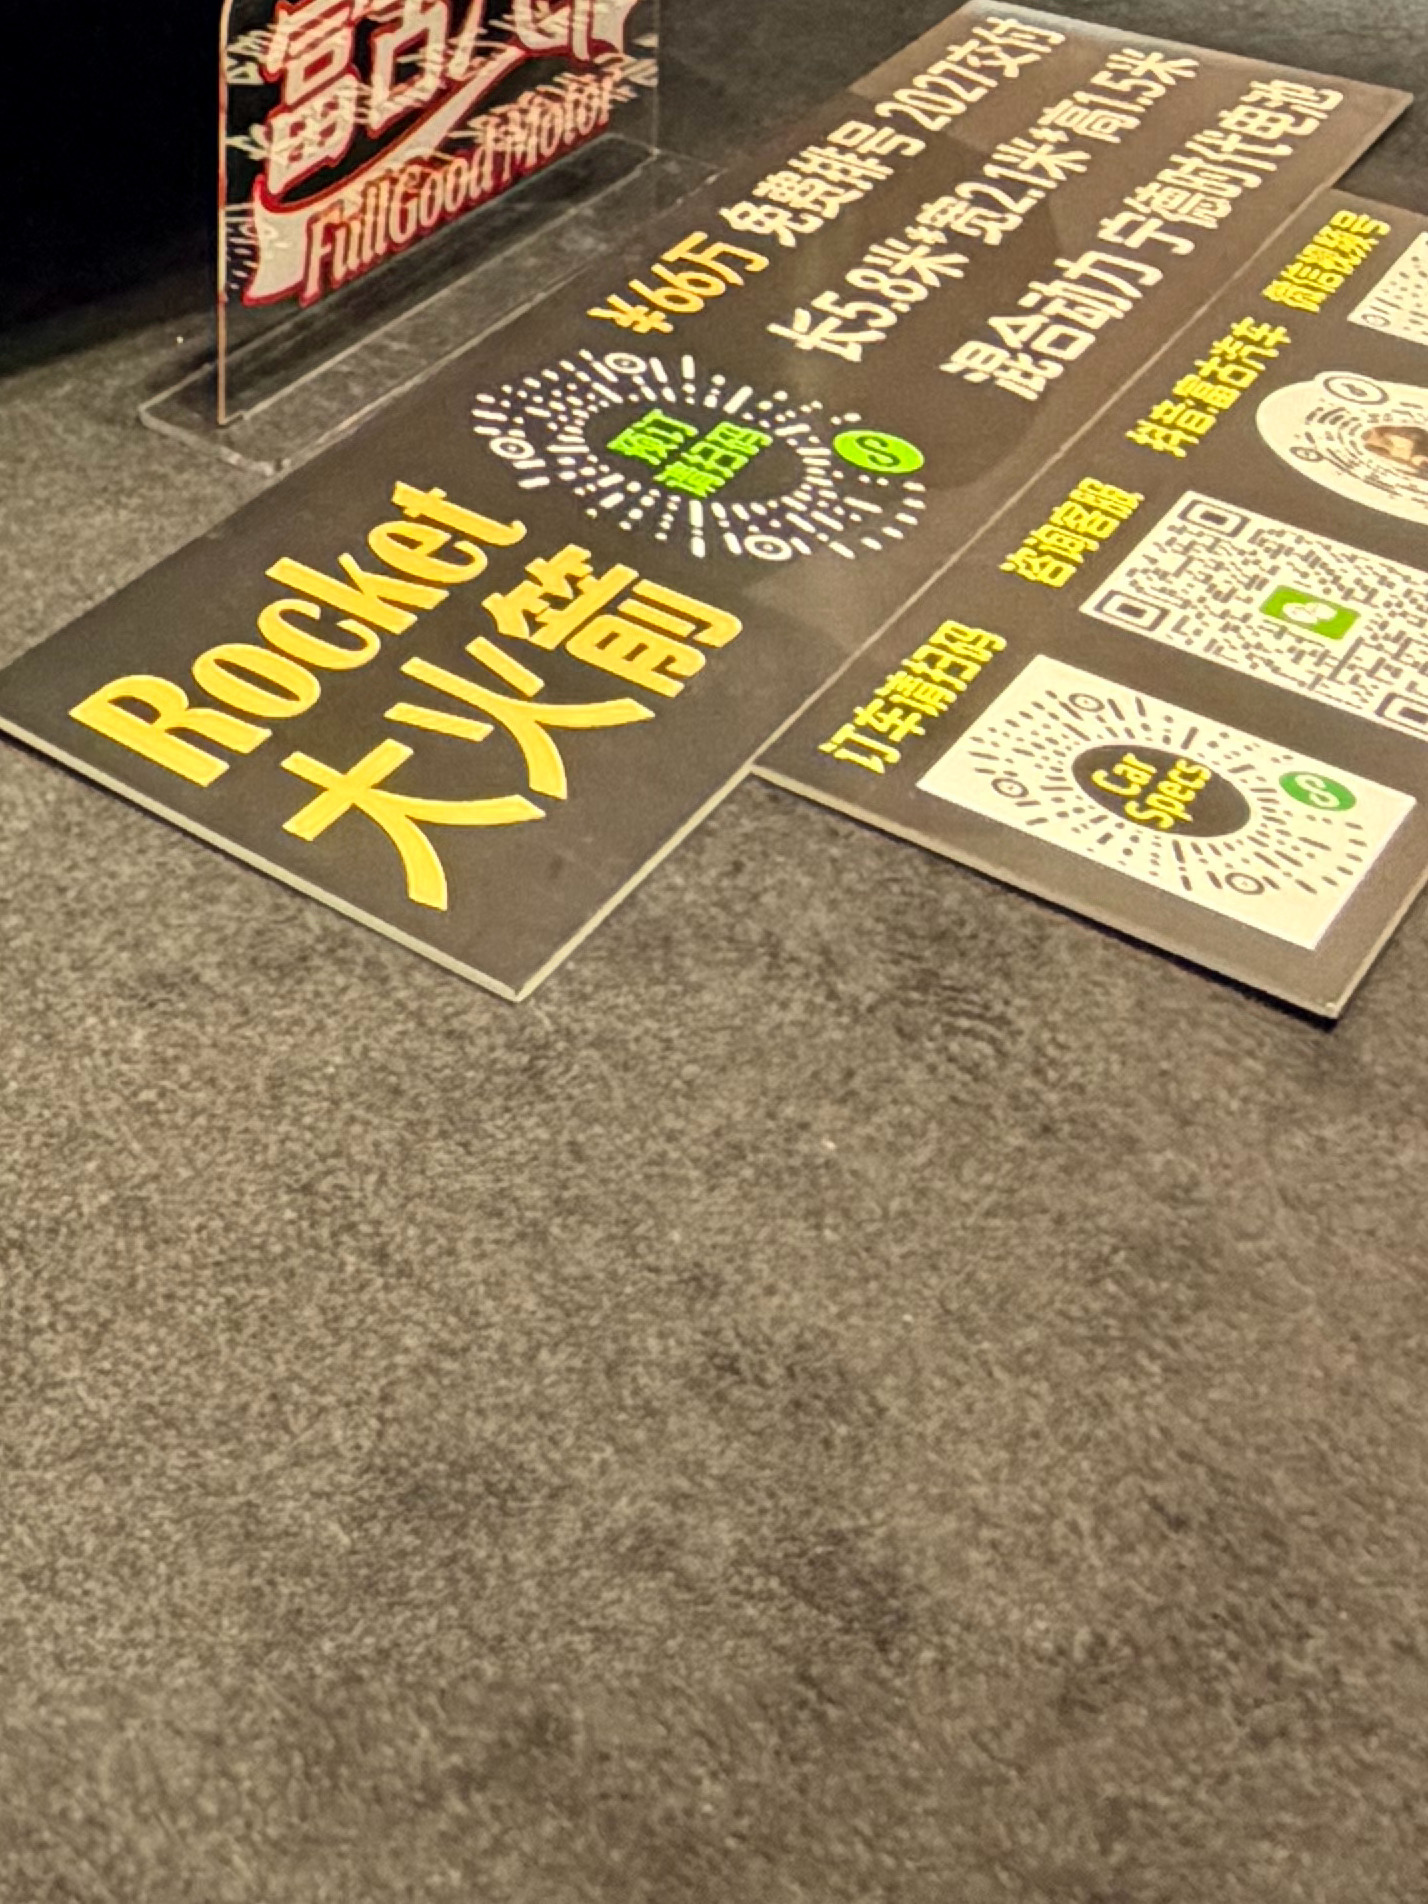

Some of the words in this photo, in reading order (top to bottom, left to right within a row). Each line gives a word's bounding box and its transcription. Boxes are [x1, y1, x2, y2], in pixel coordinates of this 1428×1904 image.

[587, 231, 770, 335] ¥66万
[718, 120, 927, 248] 免费排号
[874, 15, 1067, 133] 2027交付
[939, 248, 1163, 402] 混合动力
[1097, 78, 1346, 256] 宁德时代电池
[606, 407, 700, 466] 预订
[998, 477, 1145, 589] 咨询客服
[70, 481, 527, 788] Rocket
[818, 619, 1007, 774] 订车请扫码
[280, 543, 745, 912] 大火箭
[1091, 752, 1158, 798] Car
[1124, 758, 1213, 831] Specs
